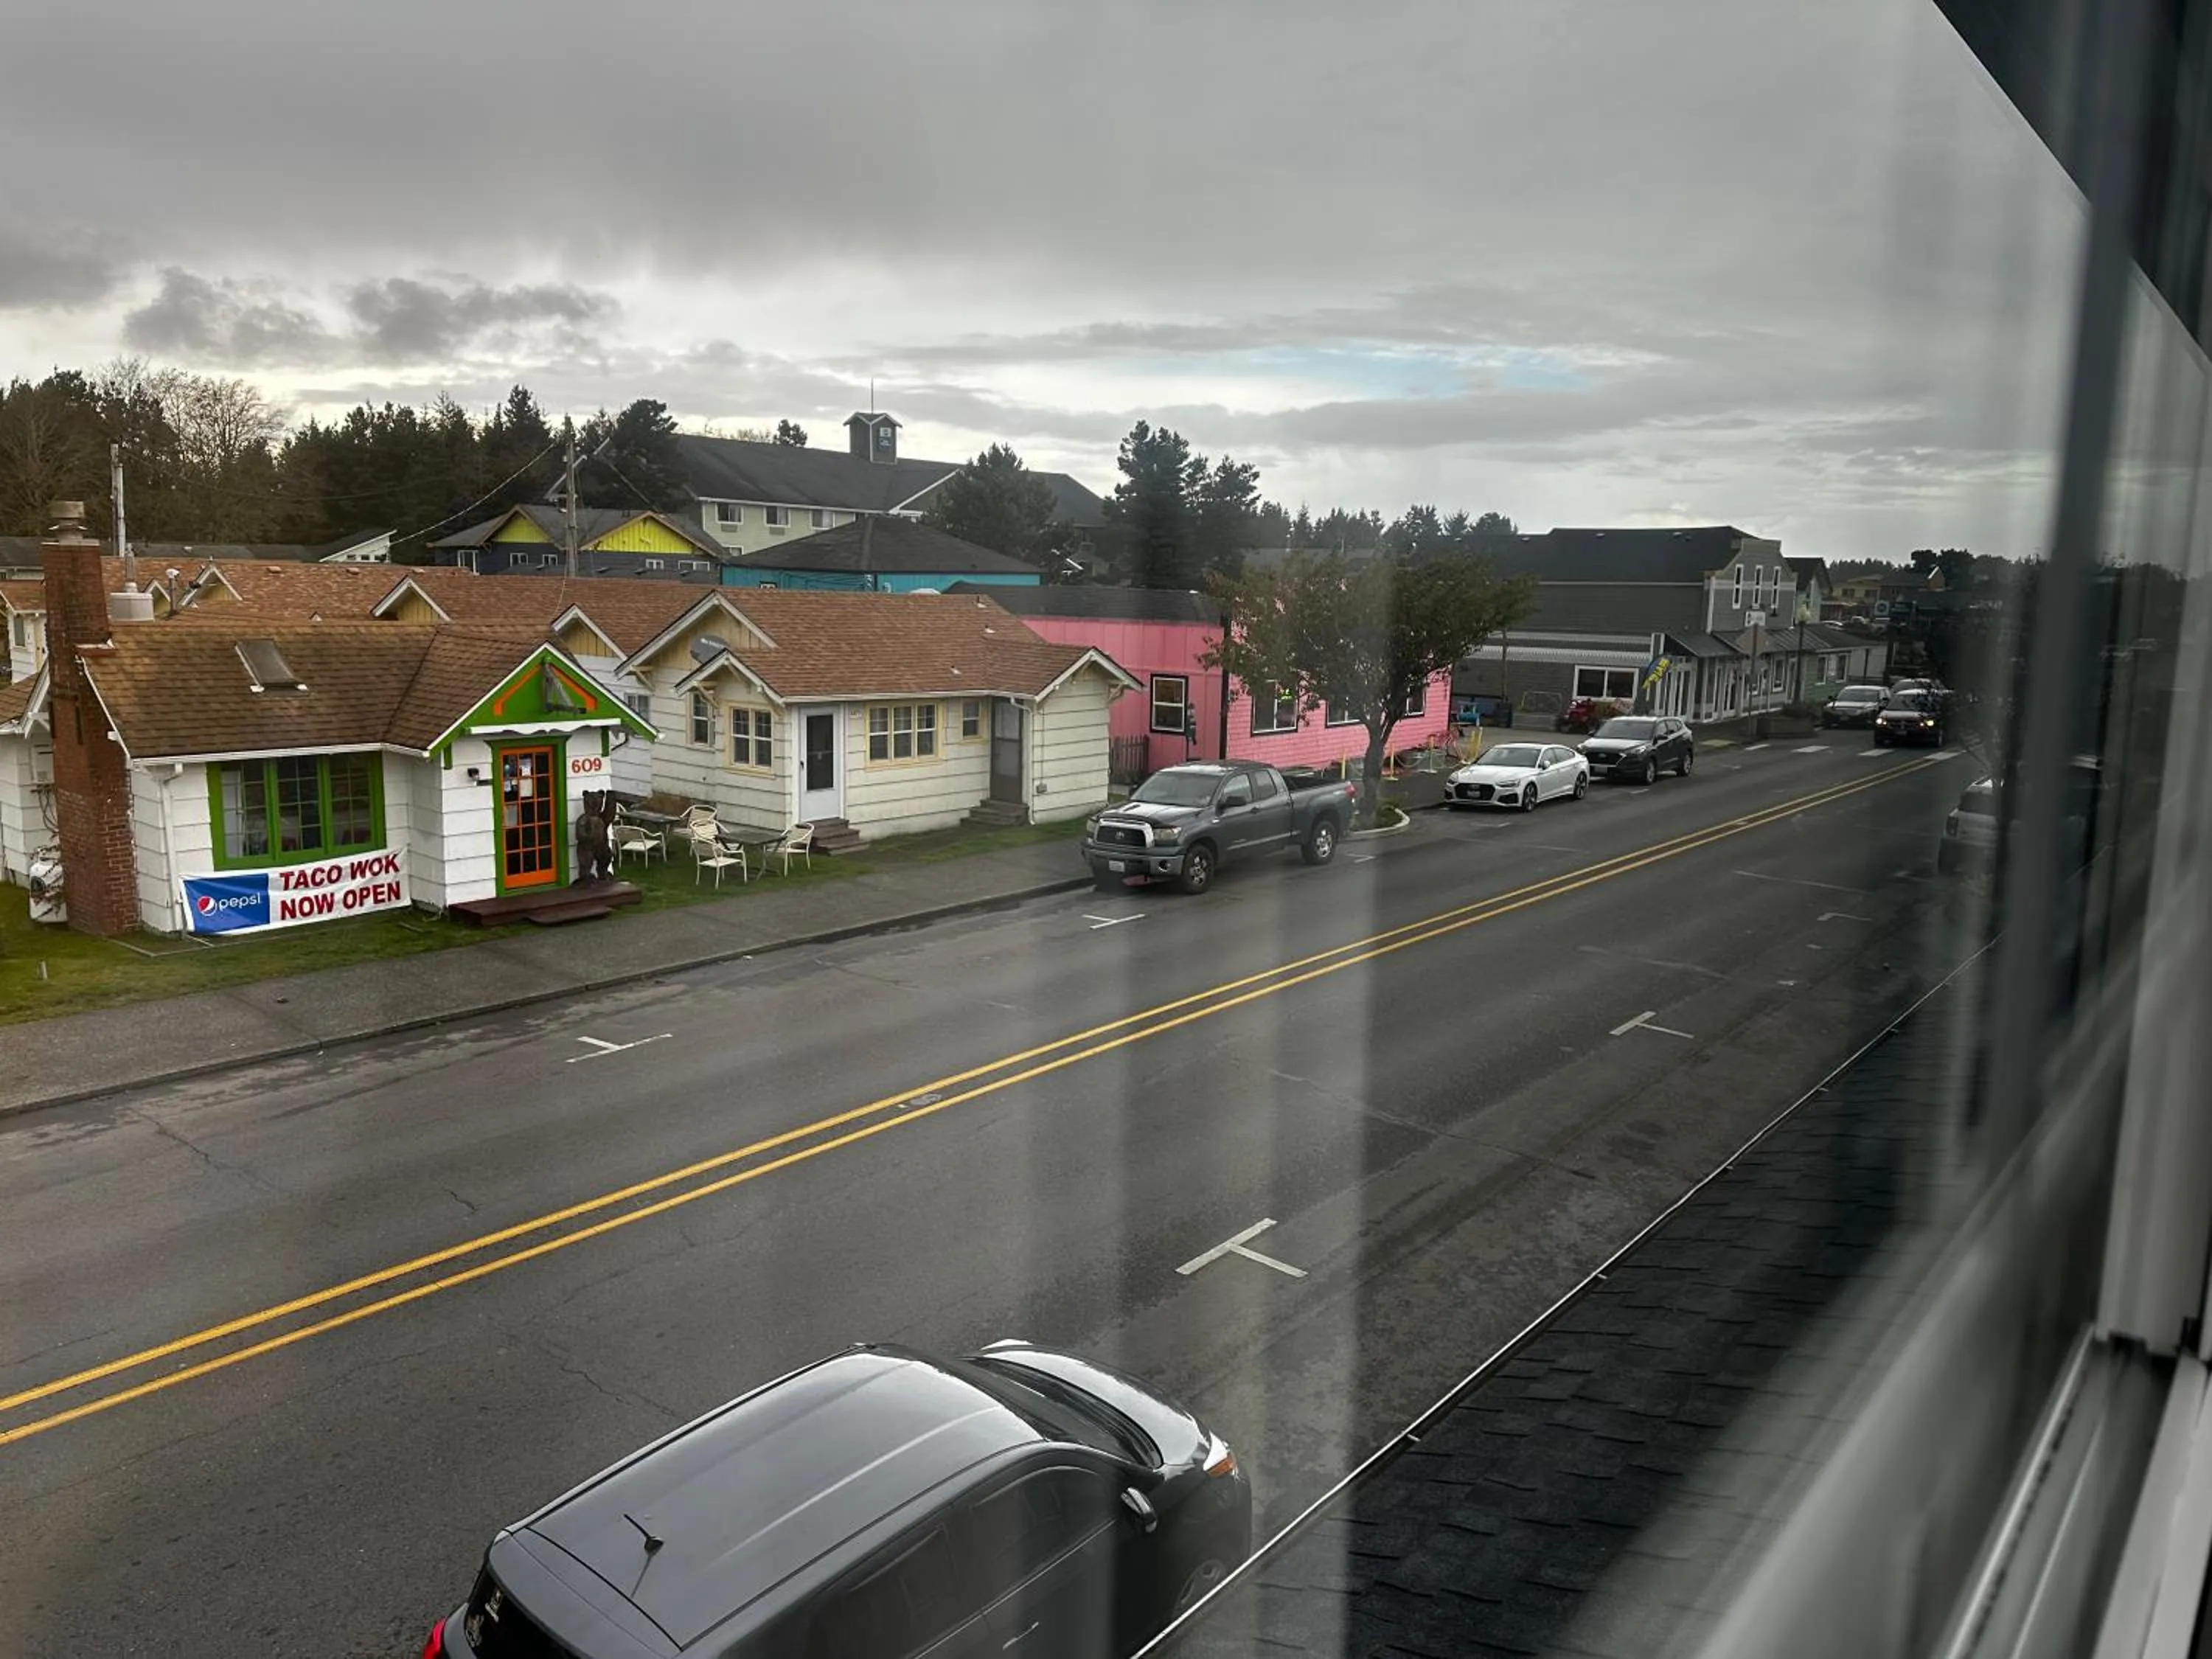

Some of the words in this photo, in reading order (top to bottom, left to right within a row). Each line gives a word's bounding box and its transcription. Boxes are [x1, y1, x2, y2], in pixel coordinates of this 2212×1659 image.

[571, 757, 602, 773] 609
[279, 865, 342, 891] TACO
[350, 853, 400, 880] WOK
[219, 891, 261, 912] pepsi
[280, 892, 335, 920] NOW
[342, 881, 401, 909] OPEN
